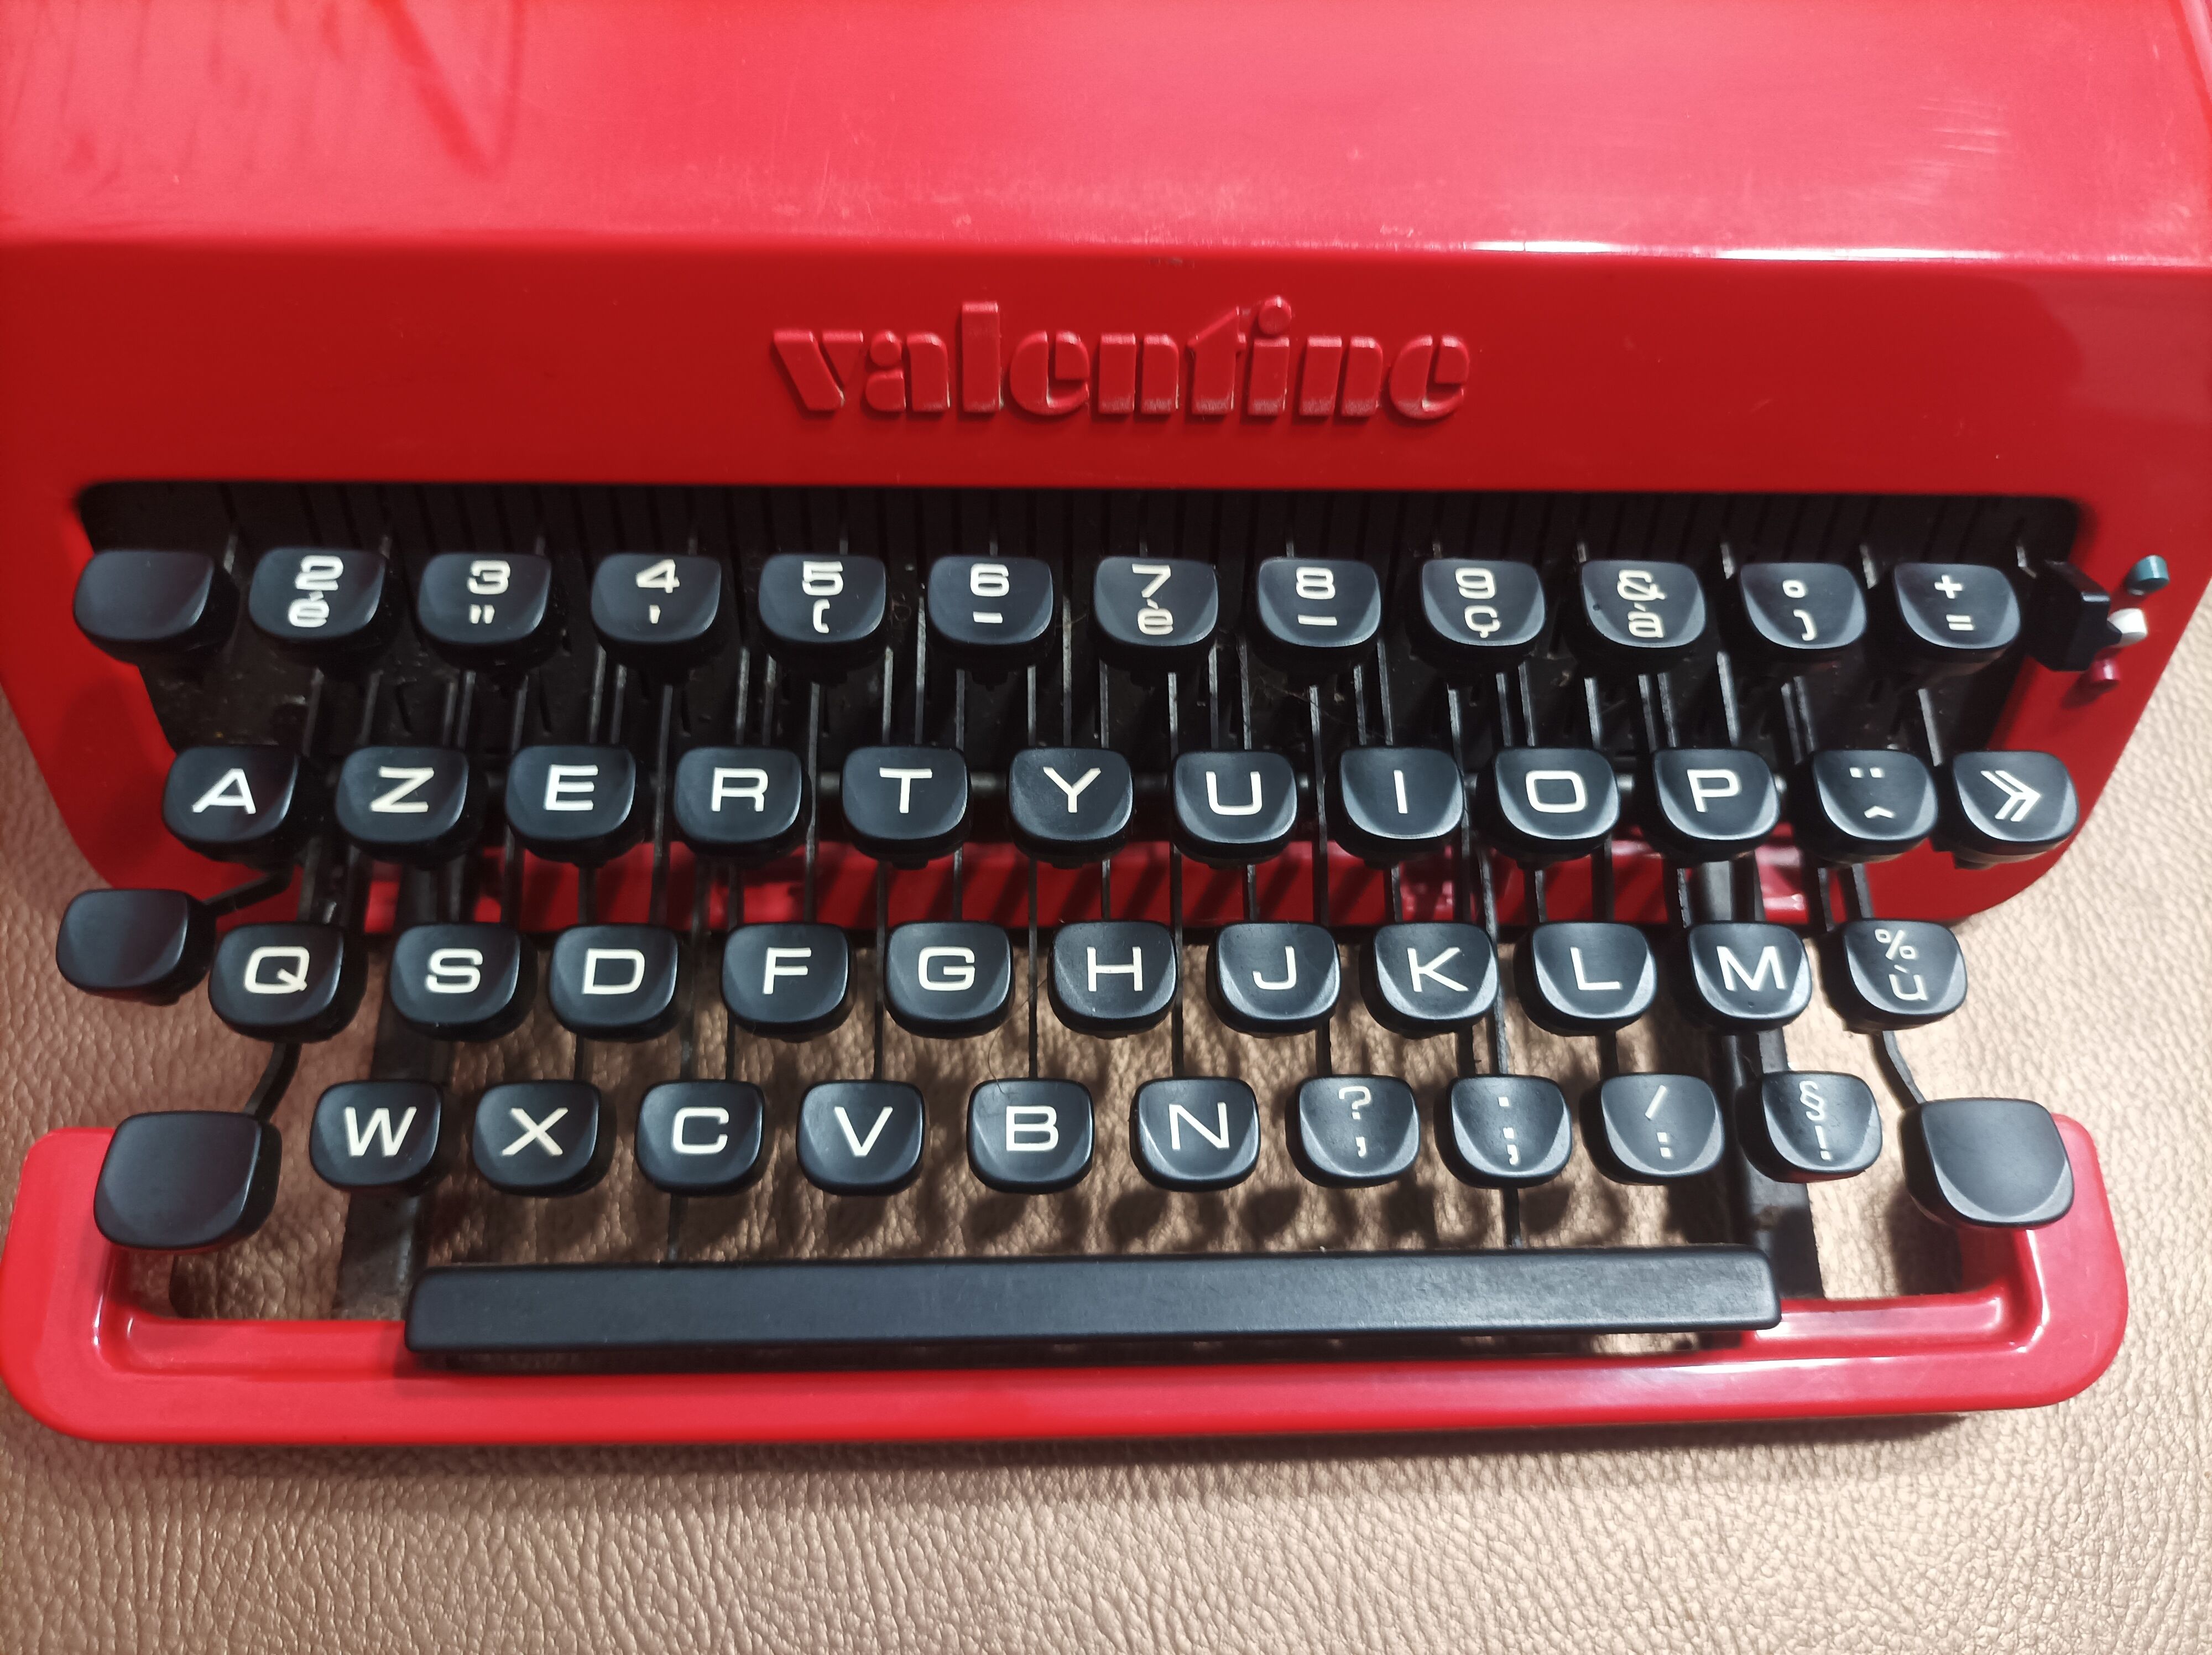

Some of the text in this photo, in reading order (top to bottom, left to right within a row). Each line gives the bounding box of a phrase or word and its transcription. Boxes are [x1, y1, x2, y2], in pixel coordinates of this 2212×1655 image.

[773, 295, 1471, 419] valentine
[294, 555, 344, 591] 2
[467, 560, 511, 595] 3
[636, 559, 680, 594] 4
[801, 560, 844, 596] 5
[969, 563, 1010, 597] 6
[1131, 563, 1172, 598] 7
[1295, 566, 1337, 600] 8
[1454, 566, 1497, 600] 9
[1616, 569, 1667, 602] &
[1934, 574, 1964, 600] +
[288, 590, 330, 628] é
[1137, 598, 1174, 636] è
[1464, 605, 1502, 639] ç
[1627, 602, 1665, 639] à
[1946, 613, 1975, 632] =
[192, 768, 257, 815] A
[369, 766, 435, 814] Z
[544, 764, 599, 811] E
[711, 767, 769, 813] R
[879, 767, 933, 814] T
[1042, 766, 1102, 814] Y
[1205, 771, 1263, 816] U
[1393, 769, 1408, 815] I
[1525, 769, 1588, 814] O
[1686, 768, 1741, 813] P
[1874, 928, 1921, 960] %
[243, 946, 310, 995] Q
[425, 948, 484, 994] S
[582, 948, 646, 995] D
[762, 946, 812, 995] F
[917, 946, 976, 992] G
[1086, 946, 1144, 992] H
[1252, 945, 1297, 991] J
[1406, 946, 1469, 993] K
[1569, 946, 1623, 992] L
[1715, 945, 1788, 992] M
[1888, 964, 1935, 1002] ù
[1338, 1085, 1372, 1120] ?
[1644, 1085, 1668, 1121] /
[343, 1106, 418, 1157] W
[501, 1107, 569, 1157] X
[671, 1106, 730, 1155] C
[832, 1105, 894, 1158] V
[1005, 1105, 1060, 1153] B
[1168, 1102, 1230, 1152] N
